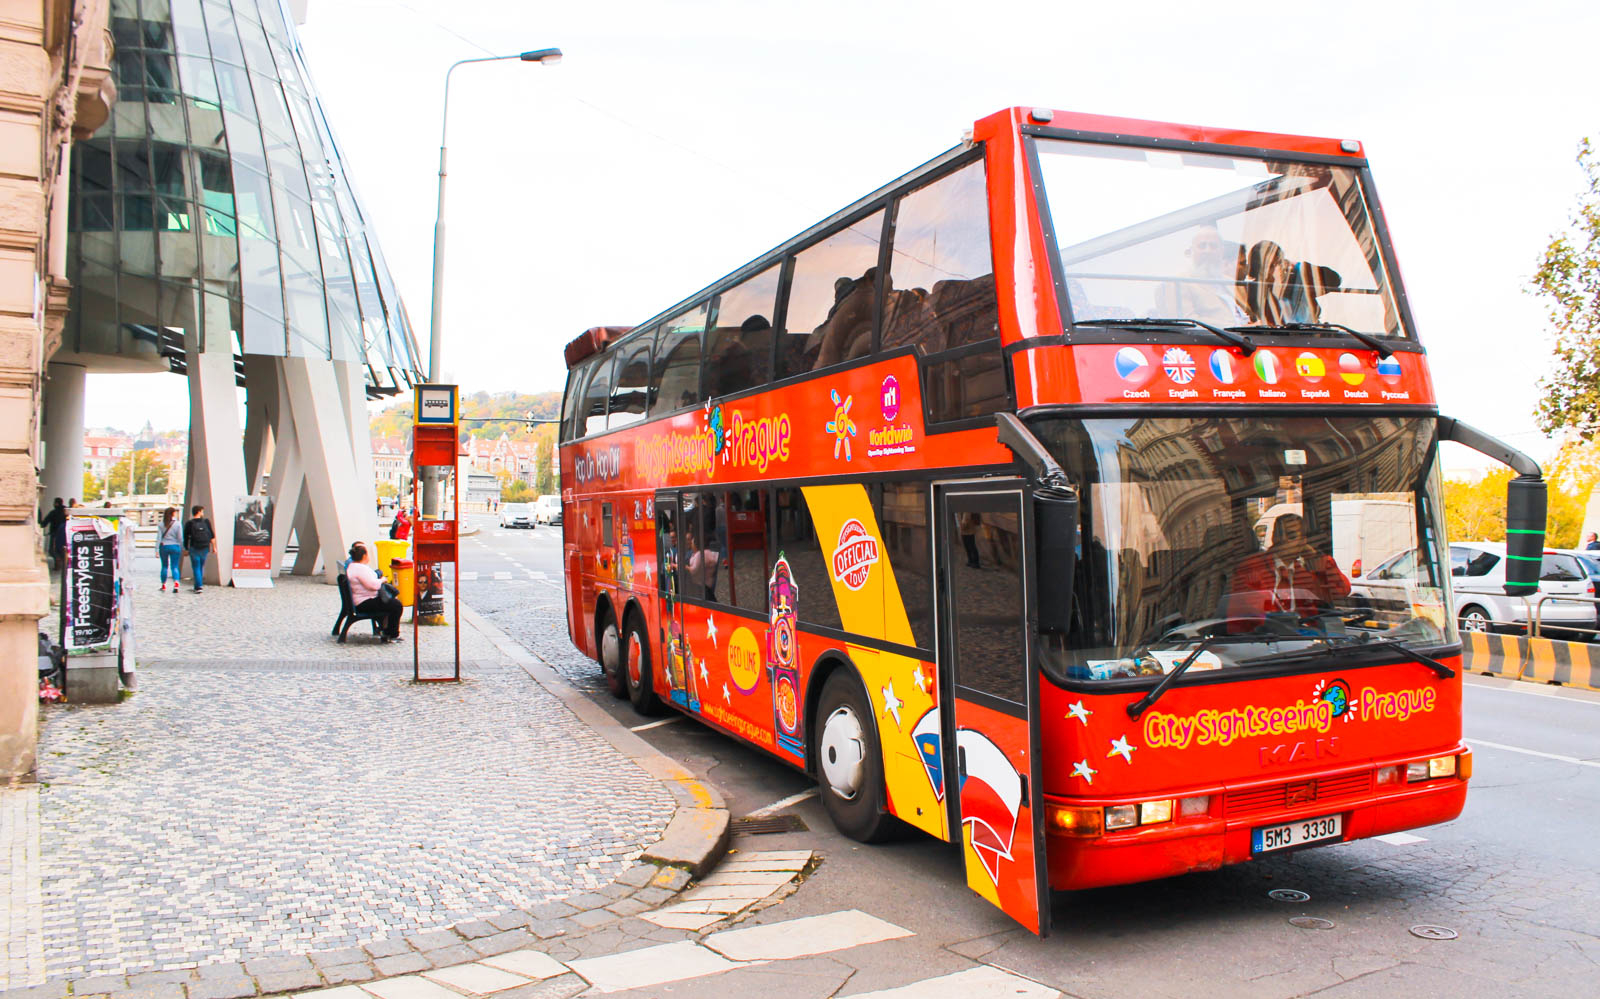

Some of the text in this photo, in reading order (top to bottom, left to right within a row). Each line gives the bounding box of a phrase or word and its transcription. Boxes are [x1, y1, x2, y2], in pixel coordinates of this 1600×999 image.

[1123, 389, 1150, 398] Czech
[1168, 389, 1198, 399] English
[1213, 388, 1246, 399] Français
[1259, 389, 1286, 397] Italiano
[1301, 389, 1330, 399] Español
[732, 409, 791, 474] Prague
[574, 446, 620, 485] Hop On Hop Off
[94, 545, 104, 567] LIVE
[837, 541, 875, 572] OFFICIAL
[73, 546, 93, 627] Freestylers
[849, 567, 867, 586] TOUR
[729, 645, 757, 675] RED LINE
[1361, 687, 1436, 721] Prague
[1259, 737, 1343, 769] MAN
[1265, 818, 1335, 848] 5M3 3330
